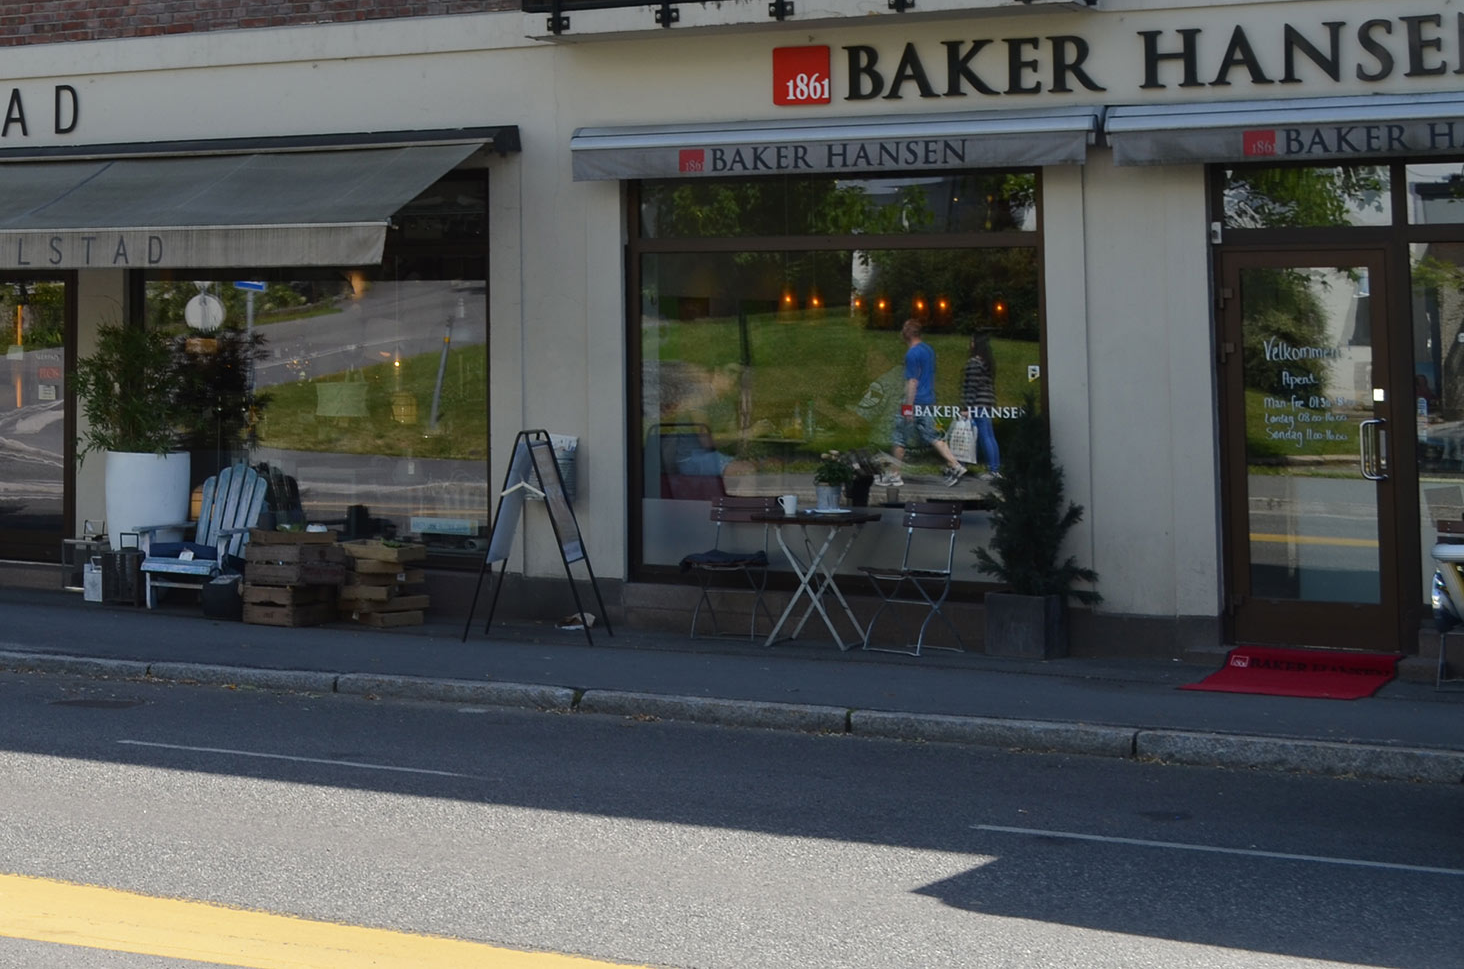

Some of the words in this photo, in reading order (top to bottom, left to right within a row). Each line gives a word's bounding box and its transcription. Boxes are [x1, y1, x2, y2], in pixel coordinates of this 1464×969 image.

[841, 35, 1107, 101] BAKER
[1137, 12, 1464, 90] HANSE
[786, 72, 830, 100] 1861
[1285, 124, 1413, 155] BAKER
[1426, 121, 1464, 151] H
[710, 145, 815, 172] BAKER
[825, 139, 968, 168] HANSEN
[914, 404, 962, 418] BAKER
